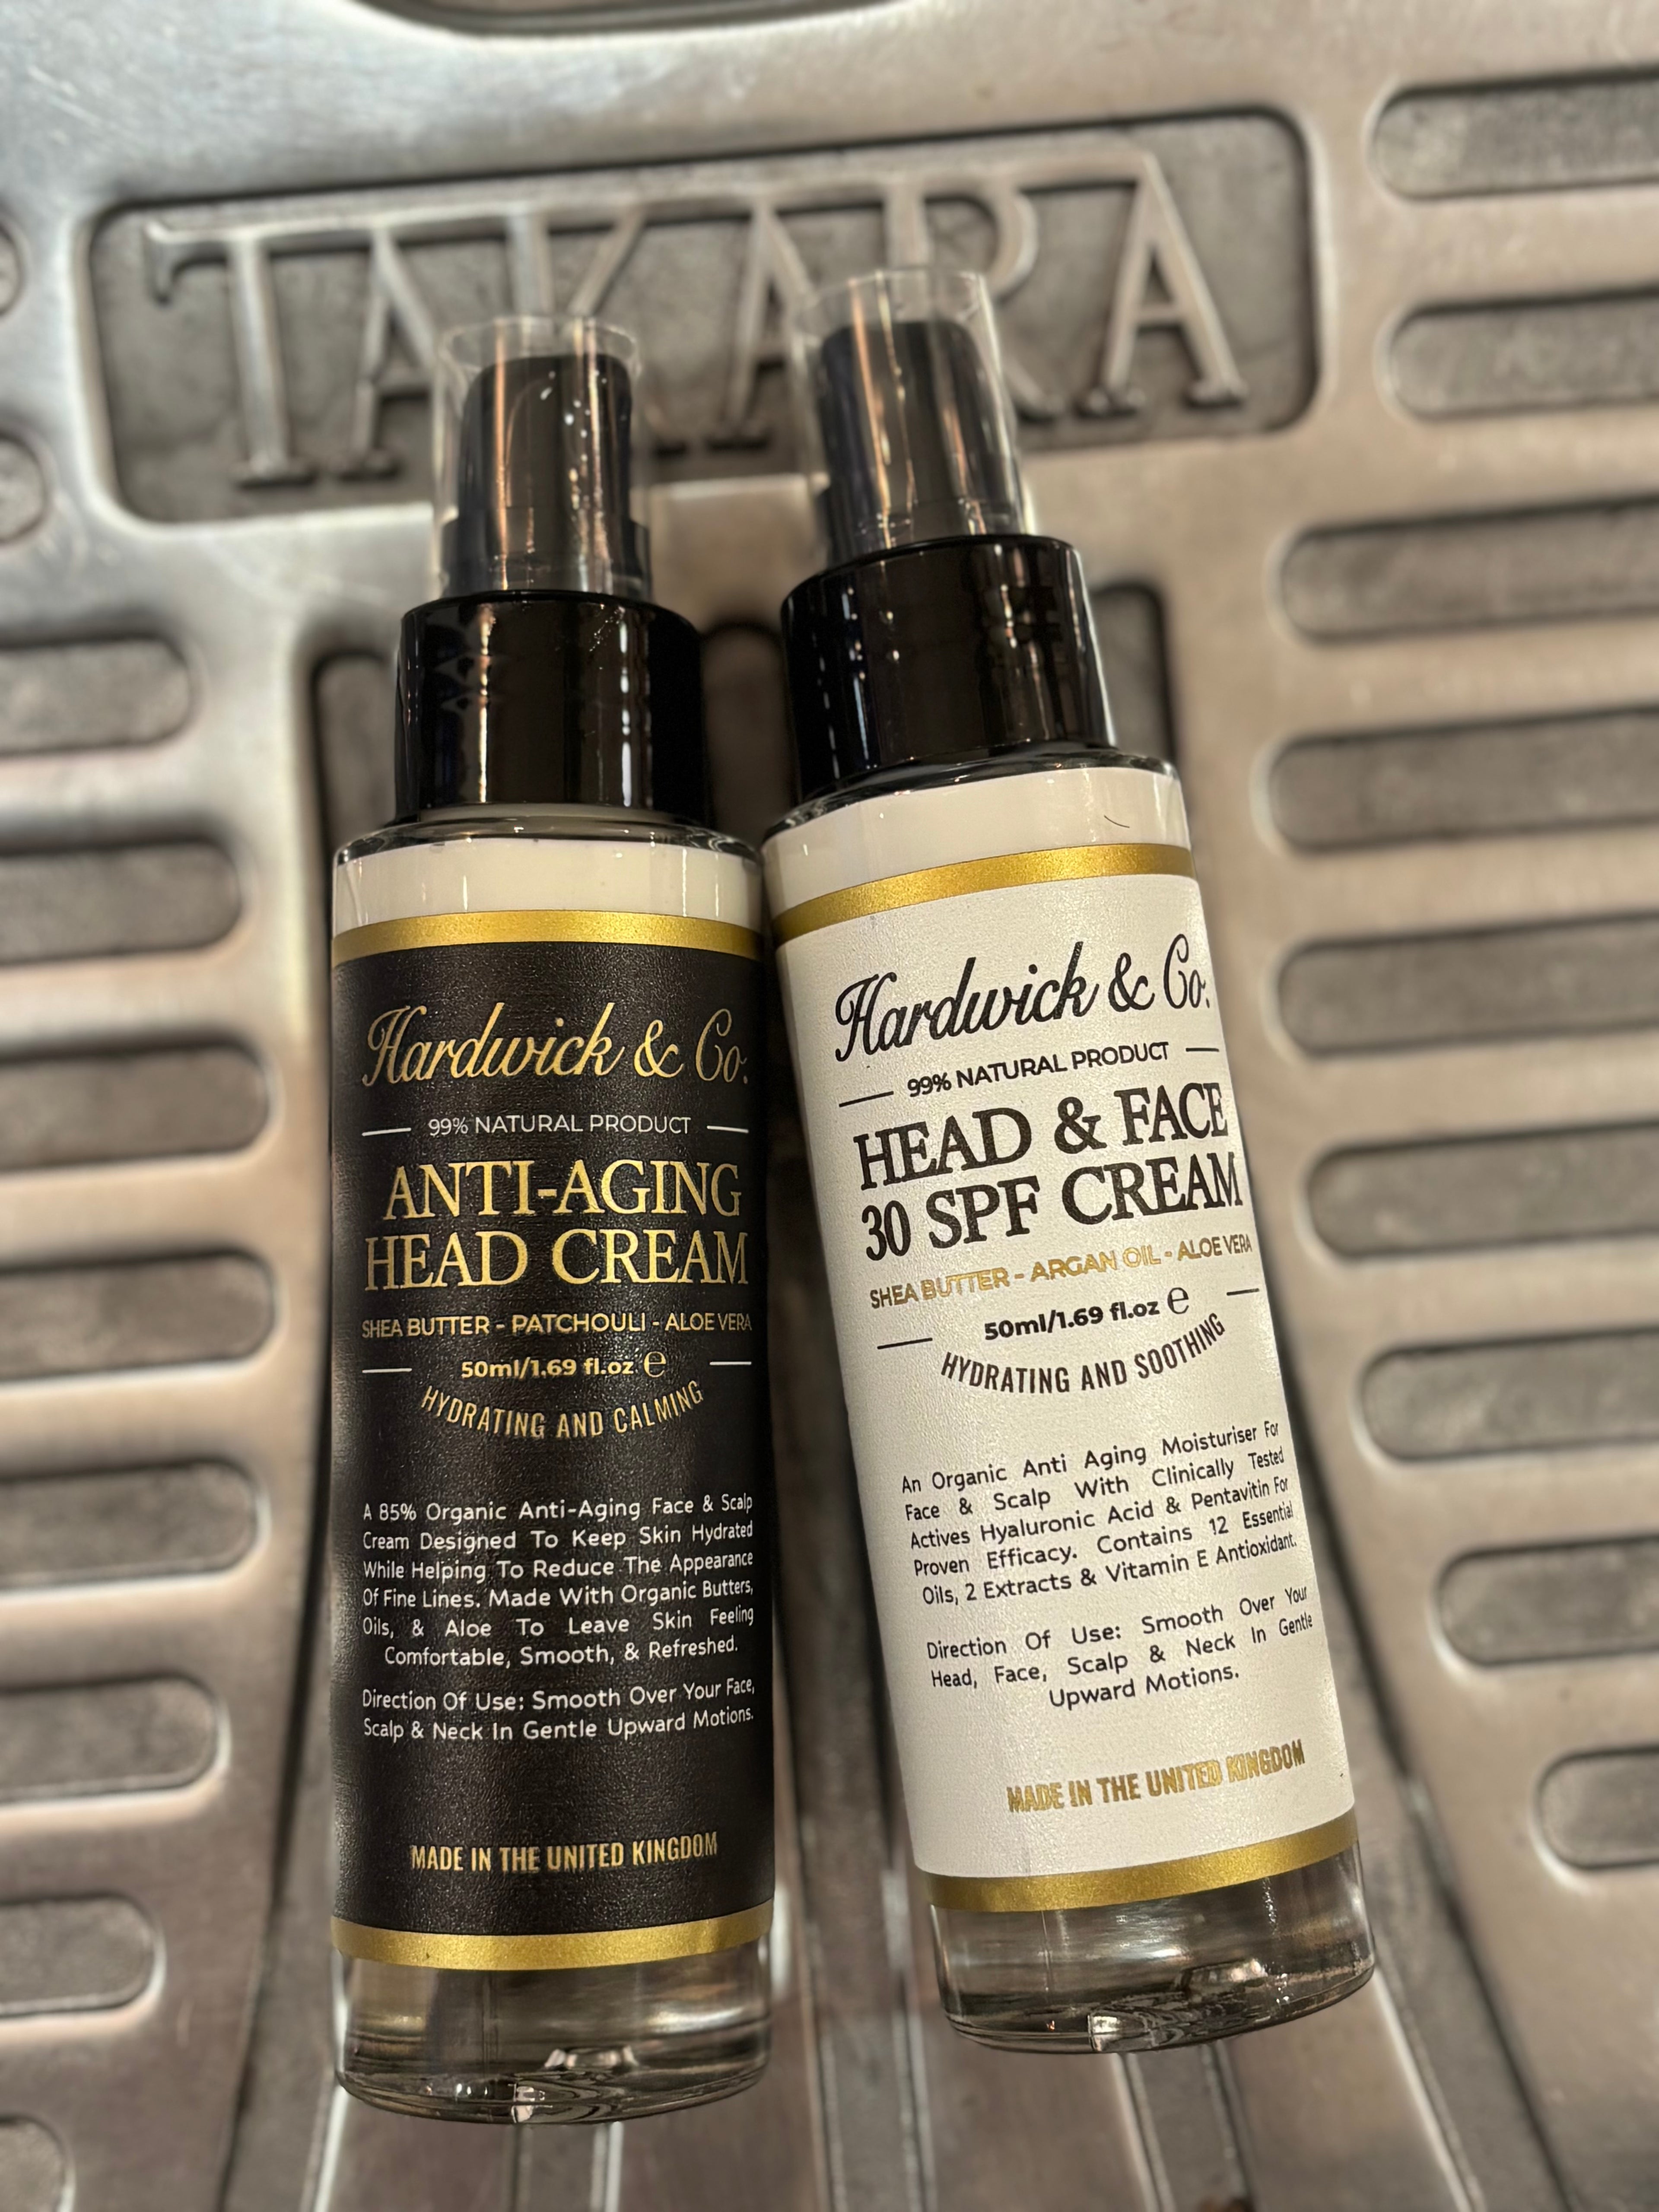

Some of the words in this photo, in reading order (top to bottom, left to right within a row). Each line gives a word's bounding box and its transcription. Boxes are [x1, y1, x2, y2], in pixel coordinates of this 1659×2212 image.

[835, 941, 1099, 1062] Hardwick
[1108, 953, 1156, 1011] &
[1163, 934, 1211, 1009] Co.
[362, 1002, 624, 1087] Hardwick
[634, 1020, 685, 1078] &
[695, 1008, 748, 1085] Co.
[907, 1072, 952, 1097] 99%
[957, 1054, 1068, 1088] NATURAL
[1072, 1042, 1170, 1070] PRODUCT
[428, 1117, 468, 1135] 99%
[475, 1115, 583, 1135] NATURAL
[589, 1115, 691, 1134] PRODUCT
[853, 1107, 1033, 1191] HEAD
[1054, 1096, 1107, 1154] &
[1114, 1082, 1228, 1147] FACE
[383, 1160, 742, 1220] ANTI-AGING
[861, 1200, 911, 1261] 30
[927, 1176, 1041, 1248] SPF
[1060, 1151, 1243, 1226] CREAM
[365, 1230, 528, 1291] HEAD
[552, 1229, 748, 1285] CREAM
[870, 1286, 918, 1309] SHEA
[921, 1268, 1009, 1301] BUTTER
[1030, 1250, 1117, 1282] ARGAN
[1122, 1246, 1161, 1268] OIL
[1176, 1237, 1222, 1259] ALOE
[1222, 1234, 1252, 1255] VERA
[361, 1319, 403, 1338] SHEA
[407, 1315, 490, 1337] BUTTER
[512, 1313, 646, 1334] PATCHOULI
[665, 1313, 714, 1332] ALOE
[715, 1313, 752, 1331] VERA
[984, 1306, 1103, 1341] 50ml/1.69
[1110, 1300, 1160, 1322] fl.oz
[461, 1359, 576, 1379] 50ml/1.69
[583, 1358, 634, 1376] fl.oz
[941, 1351, 1070, 1394] HYDRATING
[1081, 1360, 1128, 1391] AND
[1134, 1313, 1227, 1379] SOOTHING
[421, 1385, 546, 1440] HYDRATING
[556, 1411, 604, 1438] AND
[613, 1379, 704, 1433] CALMING
[902, 1476, 922, 1494] An
[931, 1465, 1007, 1494] Organic
[1023, 1454, 1067, 1478] Anti
[1084, 1445, 1147, 1471] Aging
[1161, 1427, 1258, 1457] Moisturiser
[1264, 1420, 1279, 1437] For
[905, 1503, 940, 1521] Face
[959, 1499, 973, 1515] &
[994, 1488, 1052, 1513] Scalp
[1074, 1476, 1130, 1500] With
[1152, 1458, 1234, 1487] Clinically
[1248, 1447, 1284, 1469] Tested
[363, 1505, 372, 1520] A
[379, 1503, 416, 1521] 85%
[426, 1502, 507, 1525] Organic
[518, 1499, 641, 1523] Anti-Aging
[652, 1497, 693, 1515] Face
[702, 1495, 713, 1511] &
[721, 1493, 753, 1514] Scalp
[363, 1532, 409, 1551] Cream
[420, 1531, 516, 1554] Designed
[531, 1531, 559, 1549] To
[572, 1529, 626, 1550] Keep
[639, 1526, 681, 1545] Skin
[692, 1521, 753, 1546] Hydrated
[910, 1528, 970, 1549] Actives
[980, 1511, 1095, 1545] Hyaluronic
[1107, 1502, 1154, 1524] Acid
[1165, 1496, 1181, 1513] &
[1192, 1482, 1270, 1510] Pentavitin
[1274, 1476, 1289, 1492] For
[915, 1559, 969, 1577] Proven
[987, 1543, 1077, 1571] Efficacy.
[1096, 1526, 1193, 1554] Contains
[1209, 1517, 1229, 1535] 12
[1243, 1501, 1294, 1529] Essential
[363, 1560, 405, 1579] While
[411, 1561, 486, 1583] Helping
[497, 1560, 524, 1579] To
[534, 1559, 614, 1577] Reduce
[624, 1555, 661, 1574] The
[670, 1551, 753, 1576] Appearance
[363, 1588, 379, 1606] Of
[384, 1589, 416, 1608] Fine
[423, 1590, 480, 1608] Lines.
[489, 1589, 551, 1607] Made
[559, 1586, 614, 1606] With
[621, 1581, 696, 1607] Organic
[702, 1580, 753, 1598] Butters,
[922, 1585, 959, 1606] Oils,
[966, 1583, 977, 1602] 2
[983, 1573, 1072, 1600] Extracts
[1080, 1568, 1097, 1586] &
[1106, 1554, 1190, 1583] Vitamin
[1197, 1550, 1209, 1567] E
[1216, 1531, 1297, 1565] Antioxidant.
[363, 1617, 394, 1639] Oils,
[412, 1620, 424, 1636] &
[445, 1618, 492, 1637] Aloe
[516, 1618, 544, 1636] To
[569, 1617, 629, 1634] Leave
[652, 1612, 692, 1630] Skin
[710, 1606, 754, 1626] Feeling
[385, 1646, 511, 1669] Comfortable,
[520, 1646, 615, 1666] Smooth,
[624, 1643, 639, 1660] &
[649, 1636, 738, 1659] Refreshed.
[927, 1637, 1007, 1660] Direction
[1025, 1630, 1051, 1650] Of
[1071, 1624, 1122, 1644] Use:
[1141, 1603, 1223, 1635] Smooth
[1239, 1594, 1275, 1616] Over
[1285, 1586, 1307, 1606] Your
[931, 1669, 978, 1689] Head,
[995, 1664, 1047, 1684] Face,
[1067, 1652, 1129, 1676] Scalp
[1149, 1644, 1165, 1662] &
[1186, 1633, 1236, 1658] Neck
[1251, 1626, 1266, 1643] In
[1279, 1613, 1313, 1637] Gentle
[362, 1689, 436, 1711] Direction
[442, 1692, 467, 1711] Of
[476, 1693, 524, 1711] Use:
[532, 1689, 620, 1710] Smooth
[629, 1686, 677, 1706] Over
[683, 1681, 721, 1700] Your
[727, 1677, 754, 1695] Face,
[1049, 1678, 1135, 1711] Upward
[1146, 1665, 1239, 1694] Motions.
[363, 1718, 404, 1743] Scalp
[411, 1721, 424, 1738] &
[432, 1721, 483, 1741] Neck
[493, 1722, 512, 1740] In
[523, 1719, 597, 1739] Gentle
[608, 1714, 686, 1740] Upward
[693, 1708, 754, 1728] Motions.
[1007, 1782, 1065, 1812] MADE
[1068, 1779, 1092, 1806] IN
[1097, 1773, 1141, 1804] THE
[1146, 1760, 1222, 1797] UNITED
[1227, 1739, 1306, 1783] KINGDOM
[411, 1845, 464, 1871] MADE
[471, 1846, 491, 1872] IN
[499, 1846, 540, 1873] THE
[547, 1842, 624, 1871] UNITED
[632, 1832, 717, 1863] KINGDOM
